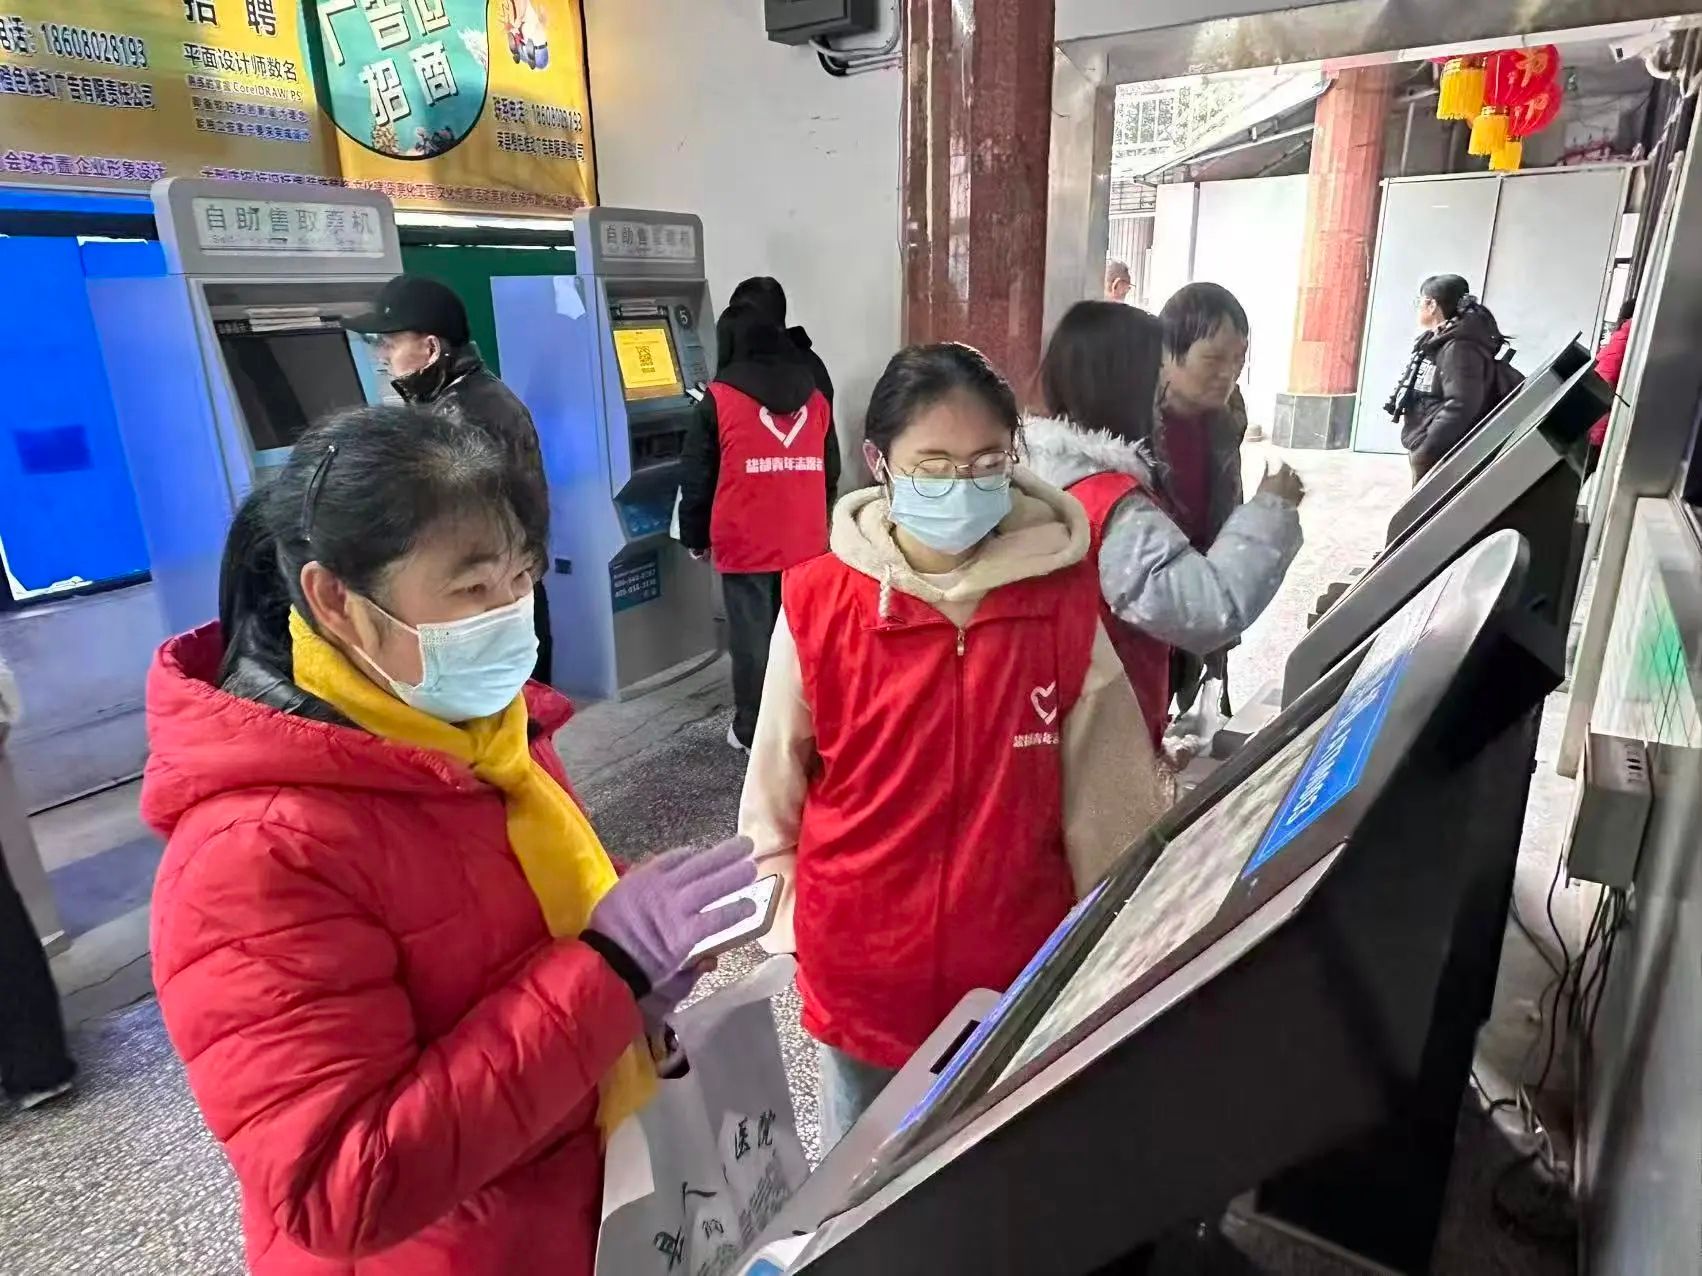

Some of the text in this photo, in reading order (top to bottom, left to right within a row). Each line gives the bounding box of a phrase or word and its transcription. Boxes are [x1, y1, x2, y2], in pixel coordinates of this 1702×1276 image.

[40, 21, 149, 69] 18608028193
[184, 43, 297, 82] 平面设计师数名
[359, 41, 459, 126] 招商
[206, 204, 373, 238] 自助售取票机
